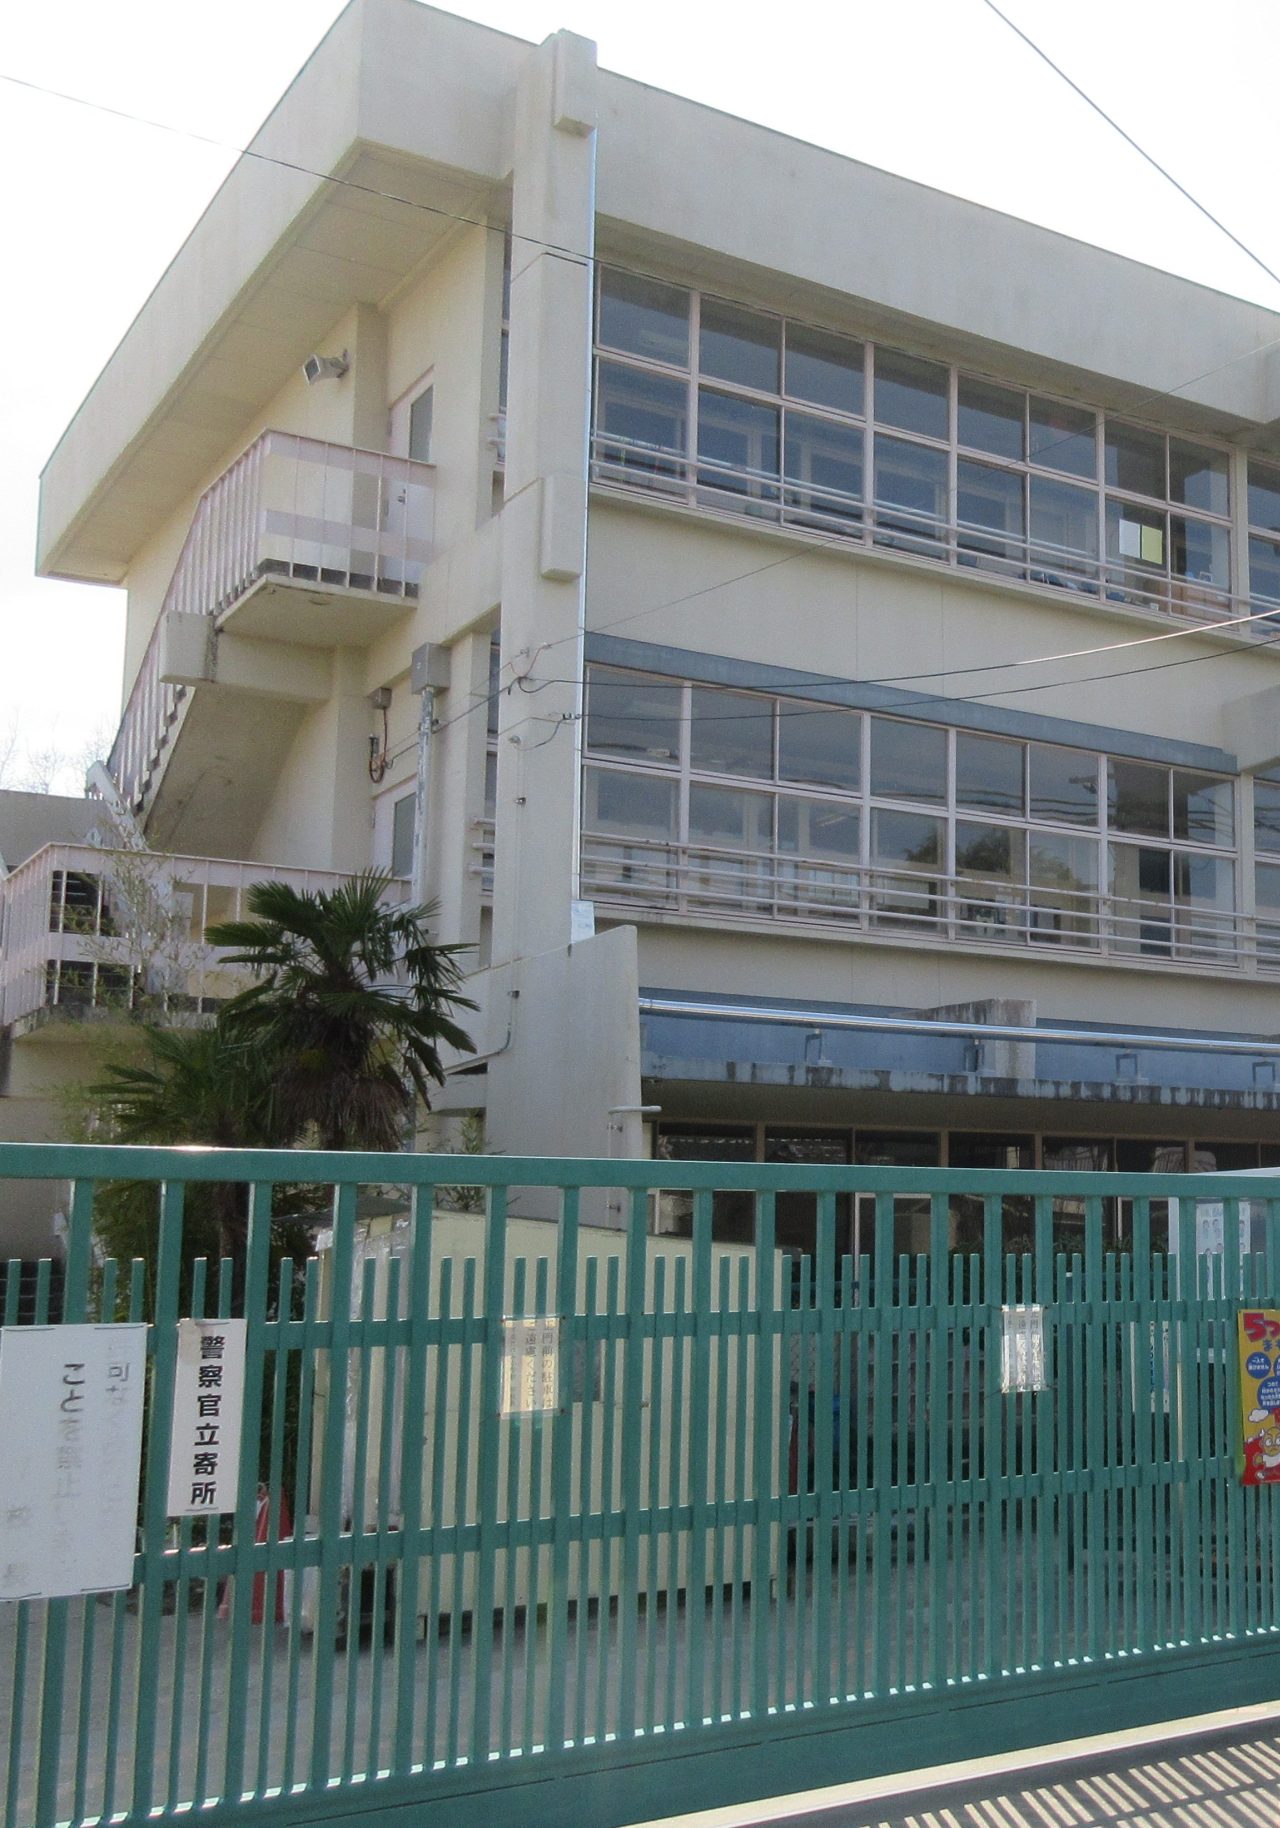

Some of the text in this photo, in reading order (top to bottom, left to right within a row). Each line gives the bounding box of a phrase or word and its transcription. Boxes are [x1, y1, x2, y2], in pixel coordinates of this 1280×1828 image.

[190, 1335, 225, 1506] 警察官立寄所
